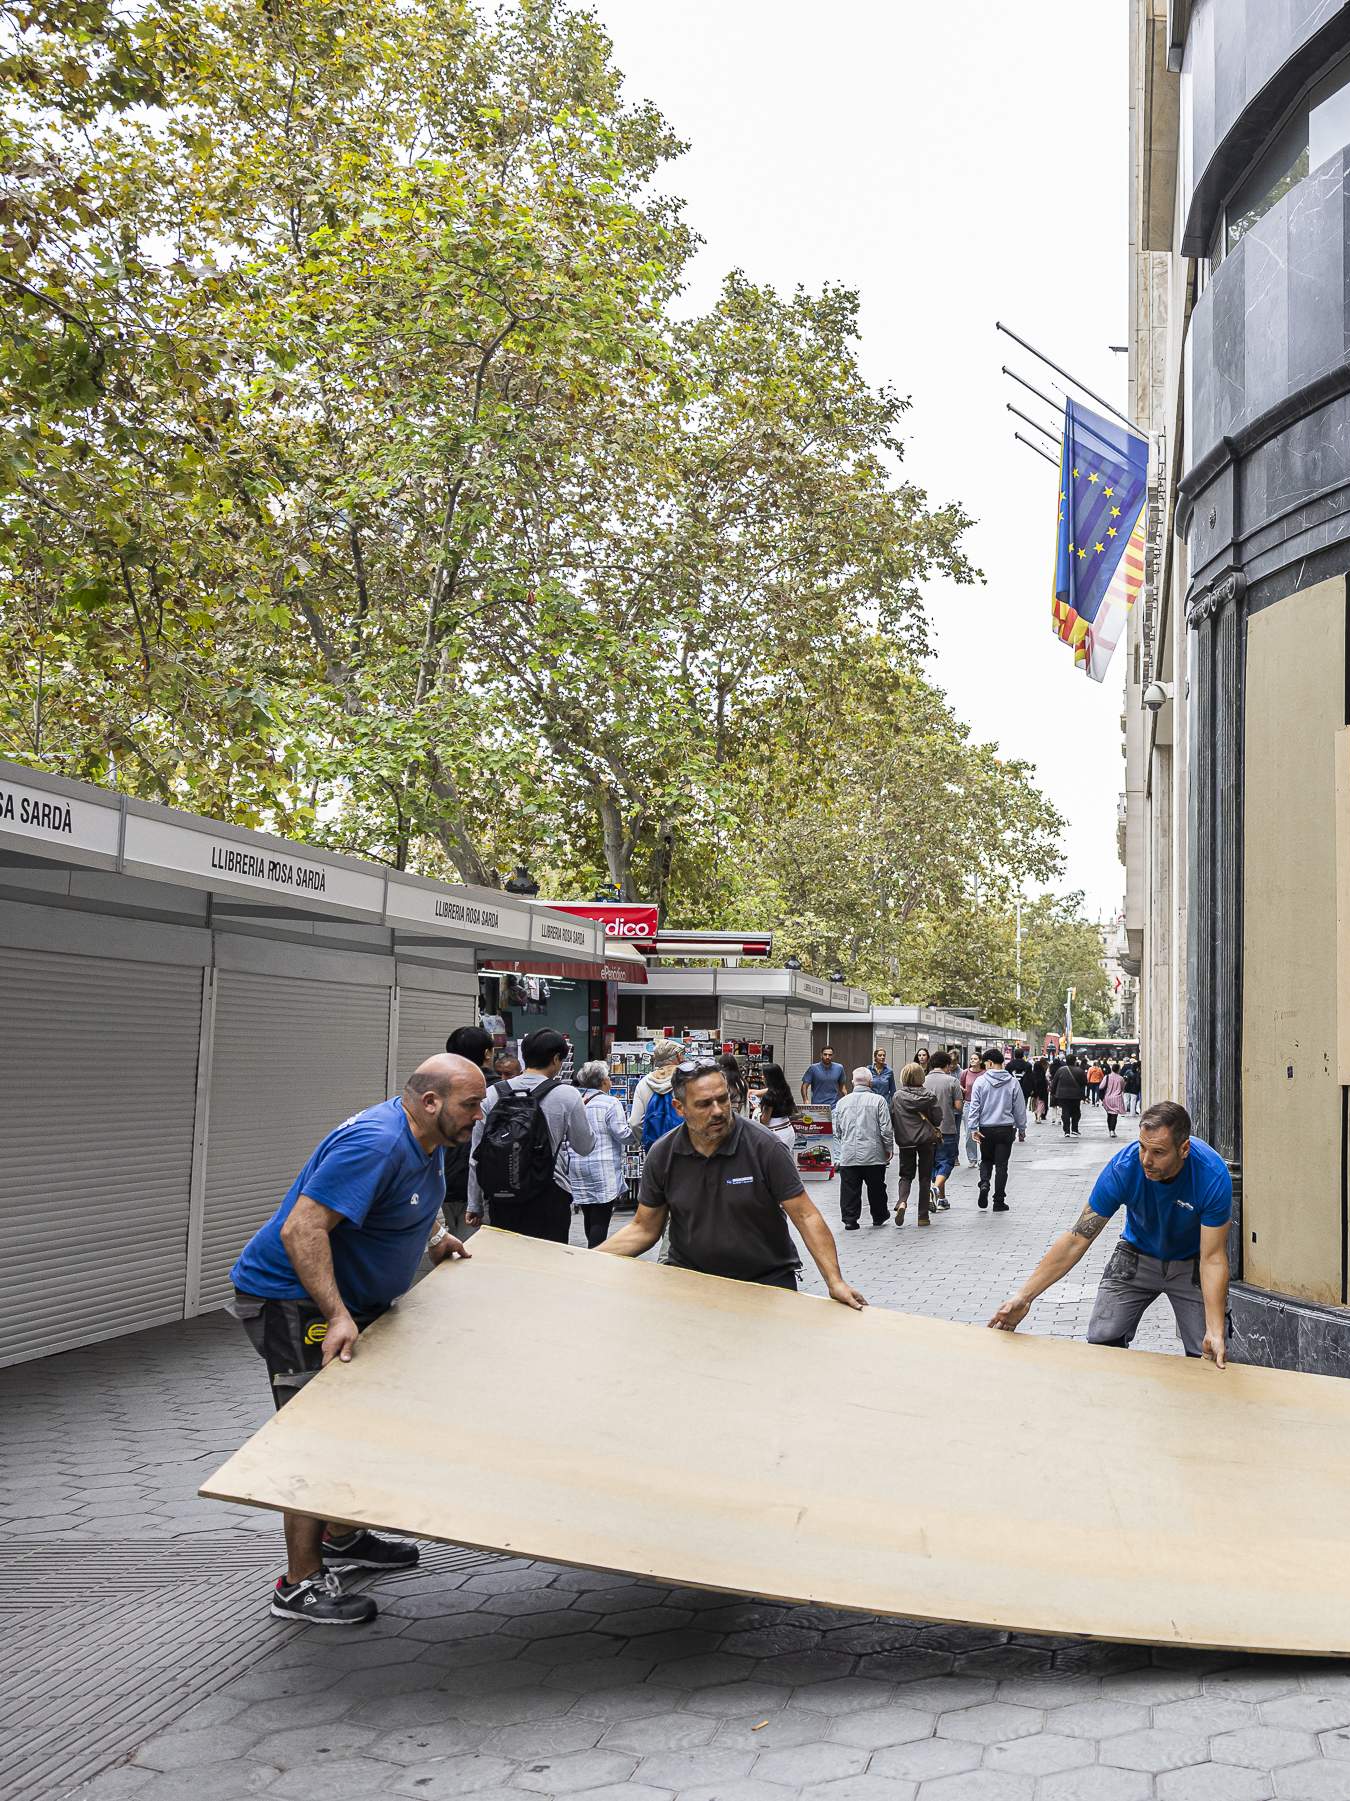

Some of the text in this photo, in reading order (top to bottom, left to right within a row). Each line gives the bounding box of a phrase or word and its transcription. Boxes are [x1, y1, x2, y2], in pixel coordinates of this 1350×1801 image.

[20, 797, 72, 834] SARDÀ
[211, 846, 326, 892] LLIBRERIA ROSA SARDÀ
[435, 899, 499, 928] LLIBRERIA ROSA SARDÀ
